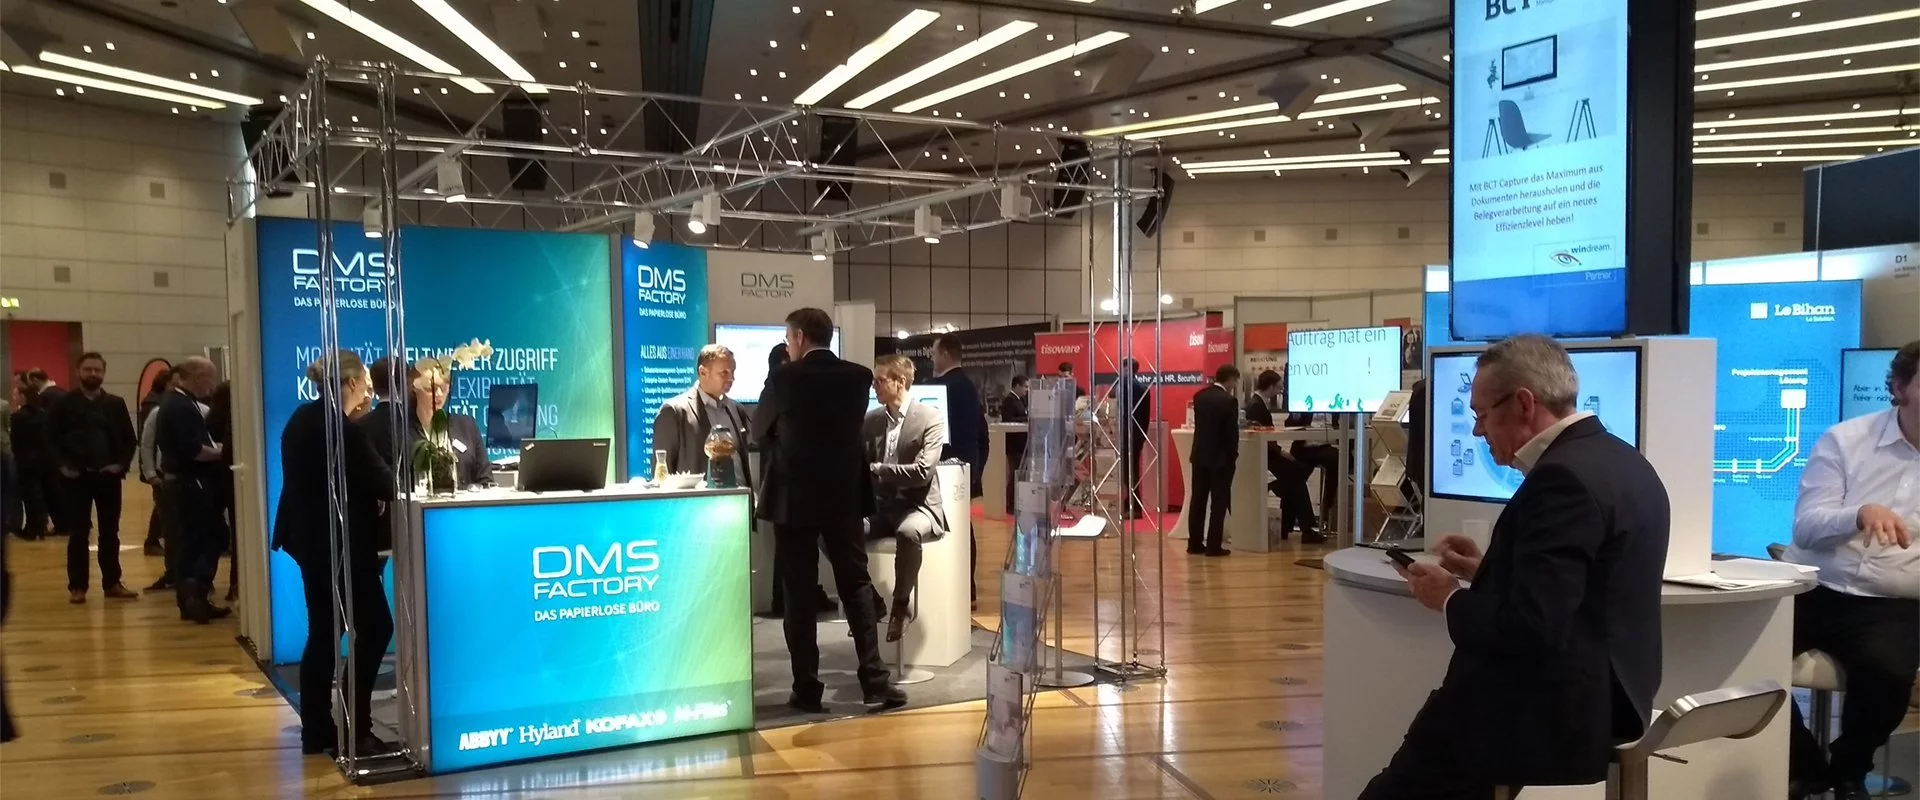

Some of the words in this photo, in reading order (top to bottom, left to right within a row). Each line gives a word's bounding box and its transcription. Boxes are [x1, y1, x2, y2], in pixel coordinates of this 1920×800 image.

[1469, 184, 1482, 193] Mit
[1484, 181, 1497, 190] BCT
[1499, 177, 1529, 189] Capture
[1530, 173, 1544, 182] das
[1546, 168, 1587, 180] Maximum
[1589, 165, 1604, 174] aus
[1471, 193, 1518, 207] Dokumenten
[1520, 185, 1568, 199] herausholen
[1570, 181, 1586, 192] und
[1587, 180, 1601, 190] die
[1474, 204, 1542, 221] Belegverarbeitung
[1543, 201, 1557, 211] auf
[1558, 200, 1571, 209] ein
[1573, 197, 1598, 207] neues
[1496, 217, 1544, 232] Effizienzlevel
[1546, 214, 1574, 226] heben!
[1895, 254, 1907, 264] D1
[637, 264, 686, 292] DMS
[741, 272, 794, 289] DMS
[1585, 271, 1611, 281] Partner
[294, 297, 312, 307] DAS
[314, 298, 368, 309] PERLOSE
[638, 288, 686, 305] FACTORY
[741, 289, 794, 299] FACTORY
[1288, 330, 1334, 348] Auftrag
[1338, 329, 1360, 344] hat
[1364, 327, 1386, 343] ein
[496, 348, 559, 371] ZUGRIFF
[640, 344, 656, 360] ALLES
[656, 344, 668, 360] AUS
[1304, 361, 1329, 376] von
[532, 539, 660, 579] DMS
[533, 573, 660, 600] FACTORY
[534, 609, 558, 622] DAS
[559, 603, 627, 620] PAPIERLOSE
[628, 600, 660, 614] BÜRO
[519, 718, 580, 746] Hyland
